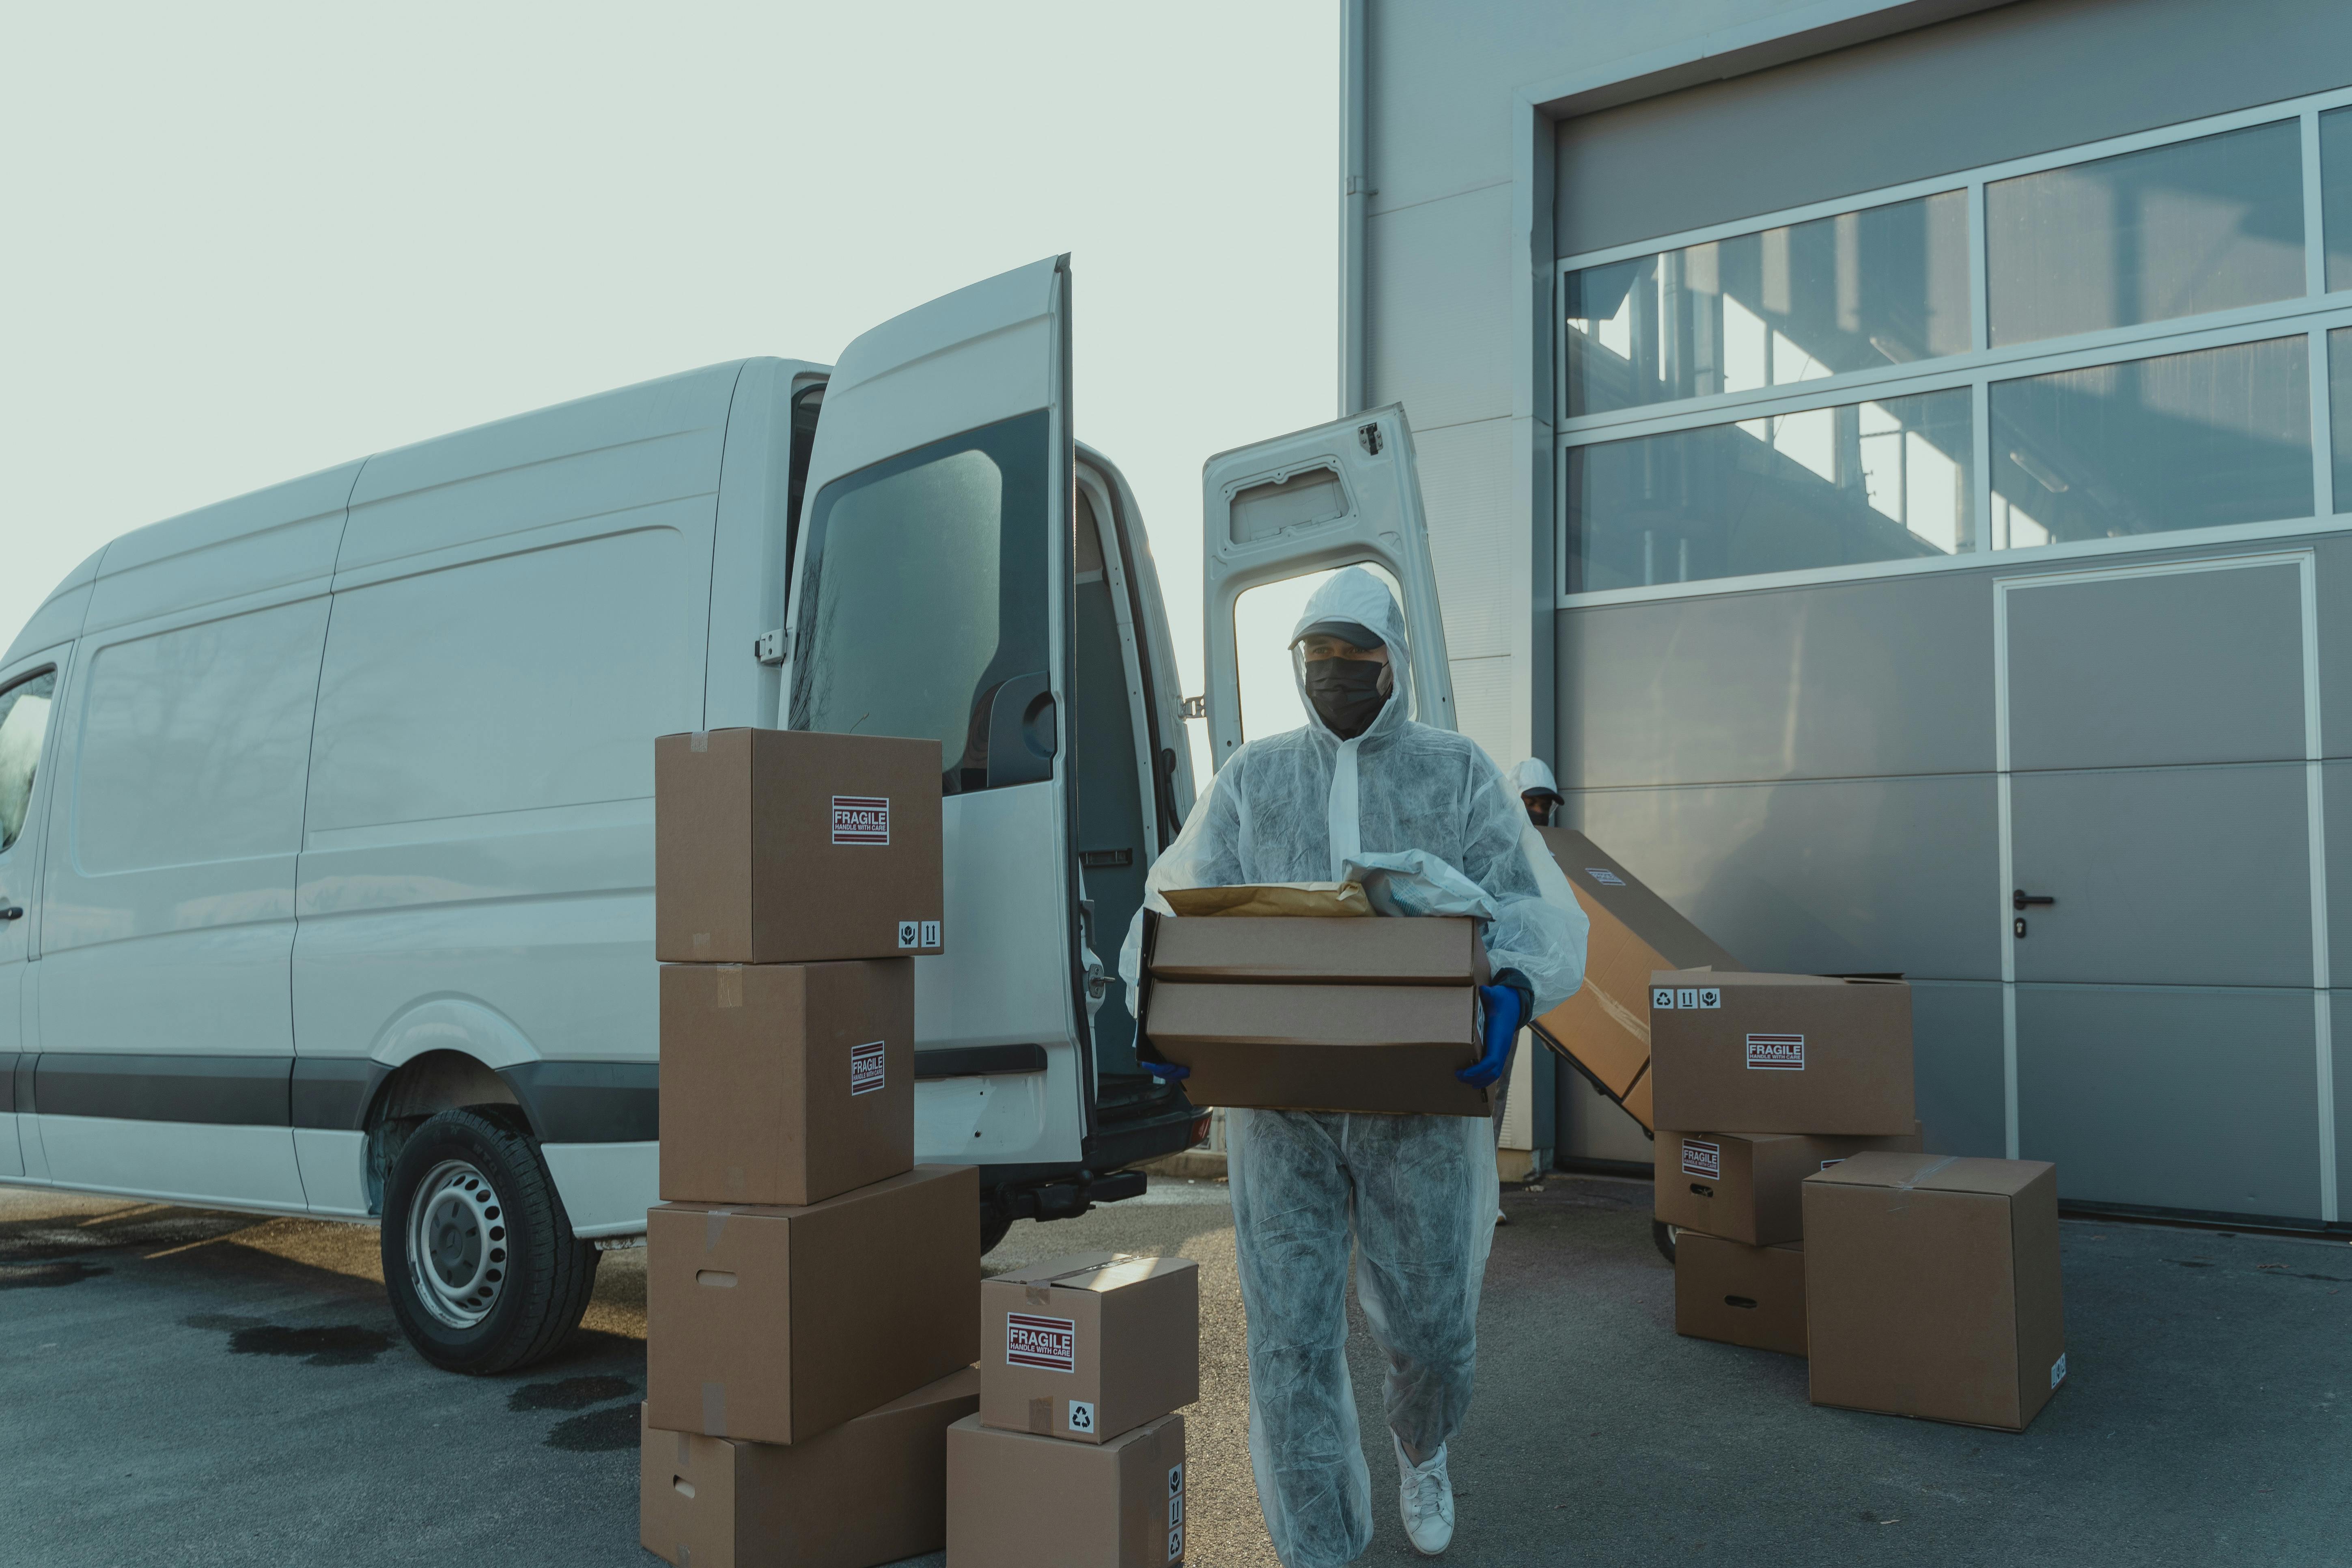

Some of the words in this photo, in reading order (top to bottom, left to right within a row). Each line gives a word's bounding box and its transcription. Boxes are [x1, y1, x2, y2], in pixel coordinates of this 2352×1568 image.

[835, 811, 886, 825] FRAGILE
[1749, 1045, 1801, 1055] FRAGILE
[853, 1056, 883, 1075] FRAGILE
[853, 1073, 866, 1081] HANDLE
[1684, 1150, 1717, 1164] FRAGILE
[1010, 1329, 1070, 1350] FRAGILE
[1010, 1342, 1035, 1352] HANDLE
[1037, 1346, 1052, 1355] WITH
[1053, 1348, 1070, 1357] CARE
